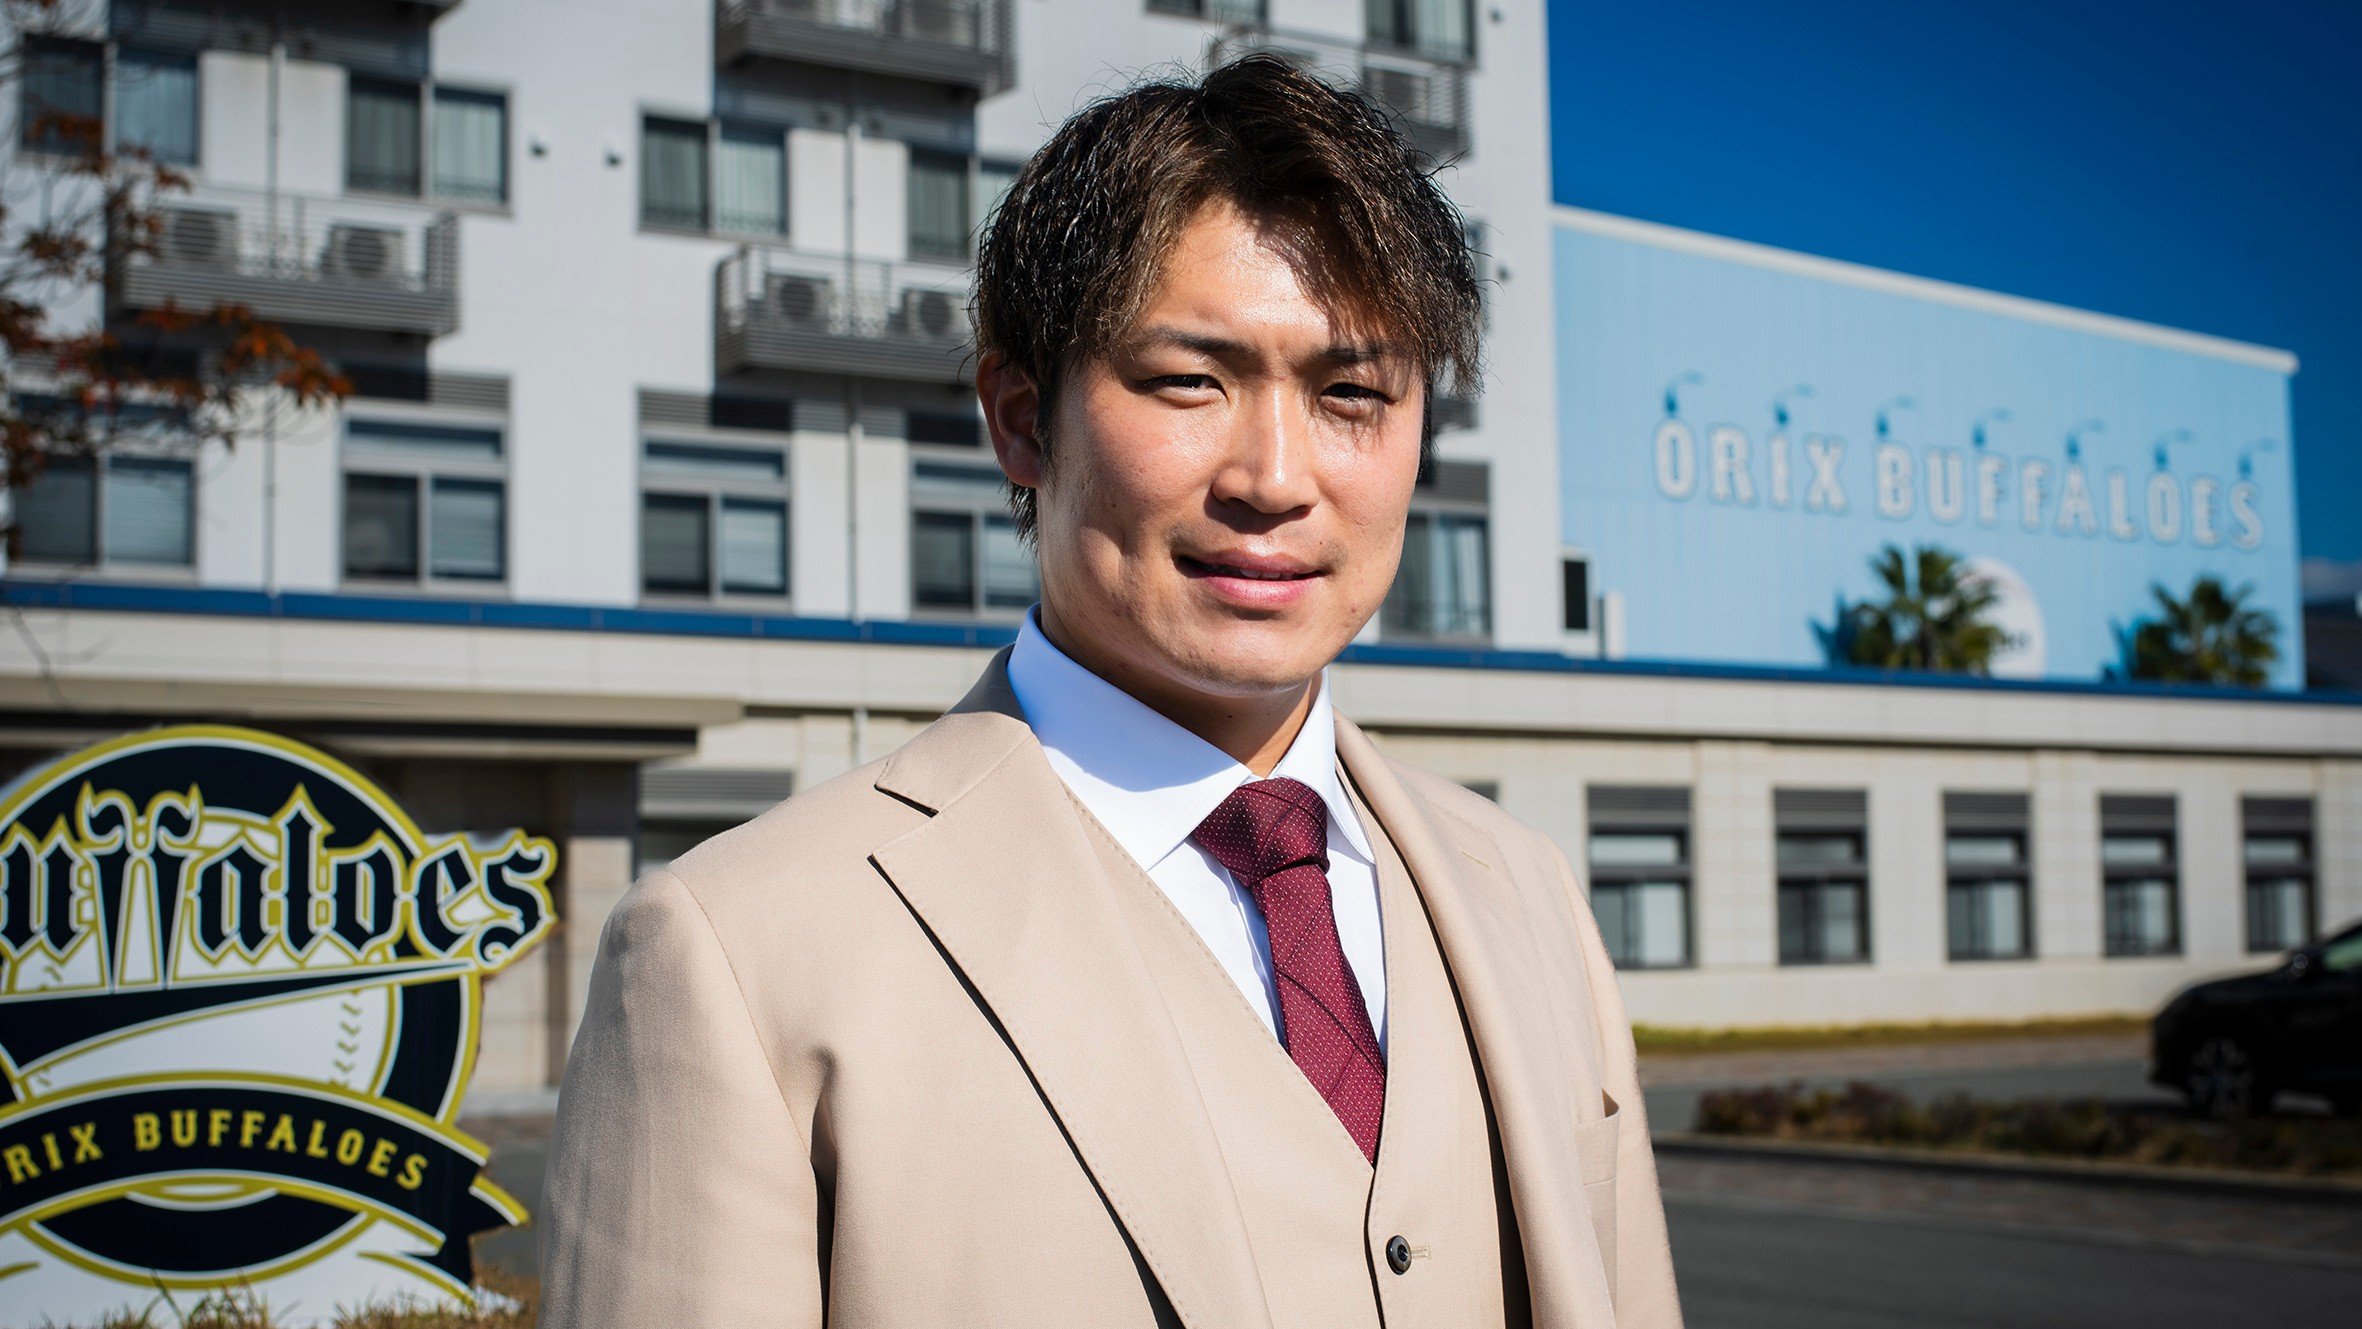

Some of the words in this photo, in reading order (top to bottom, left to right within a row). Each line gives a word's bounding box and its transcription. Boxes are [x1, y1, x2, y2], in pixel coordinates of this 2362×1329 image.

[1653, 418, 1850, 515] ORIX
[1875, 442, 2264, 553] BUFFALOES
[0, 782, 557, 993] uffaloes
[0, 1122, 103, 1185] RIX
[133, 1110, 429, 1190] BUFFALOES
